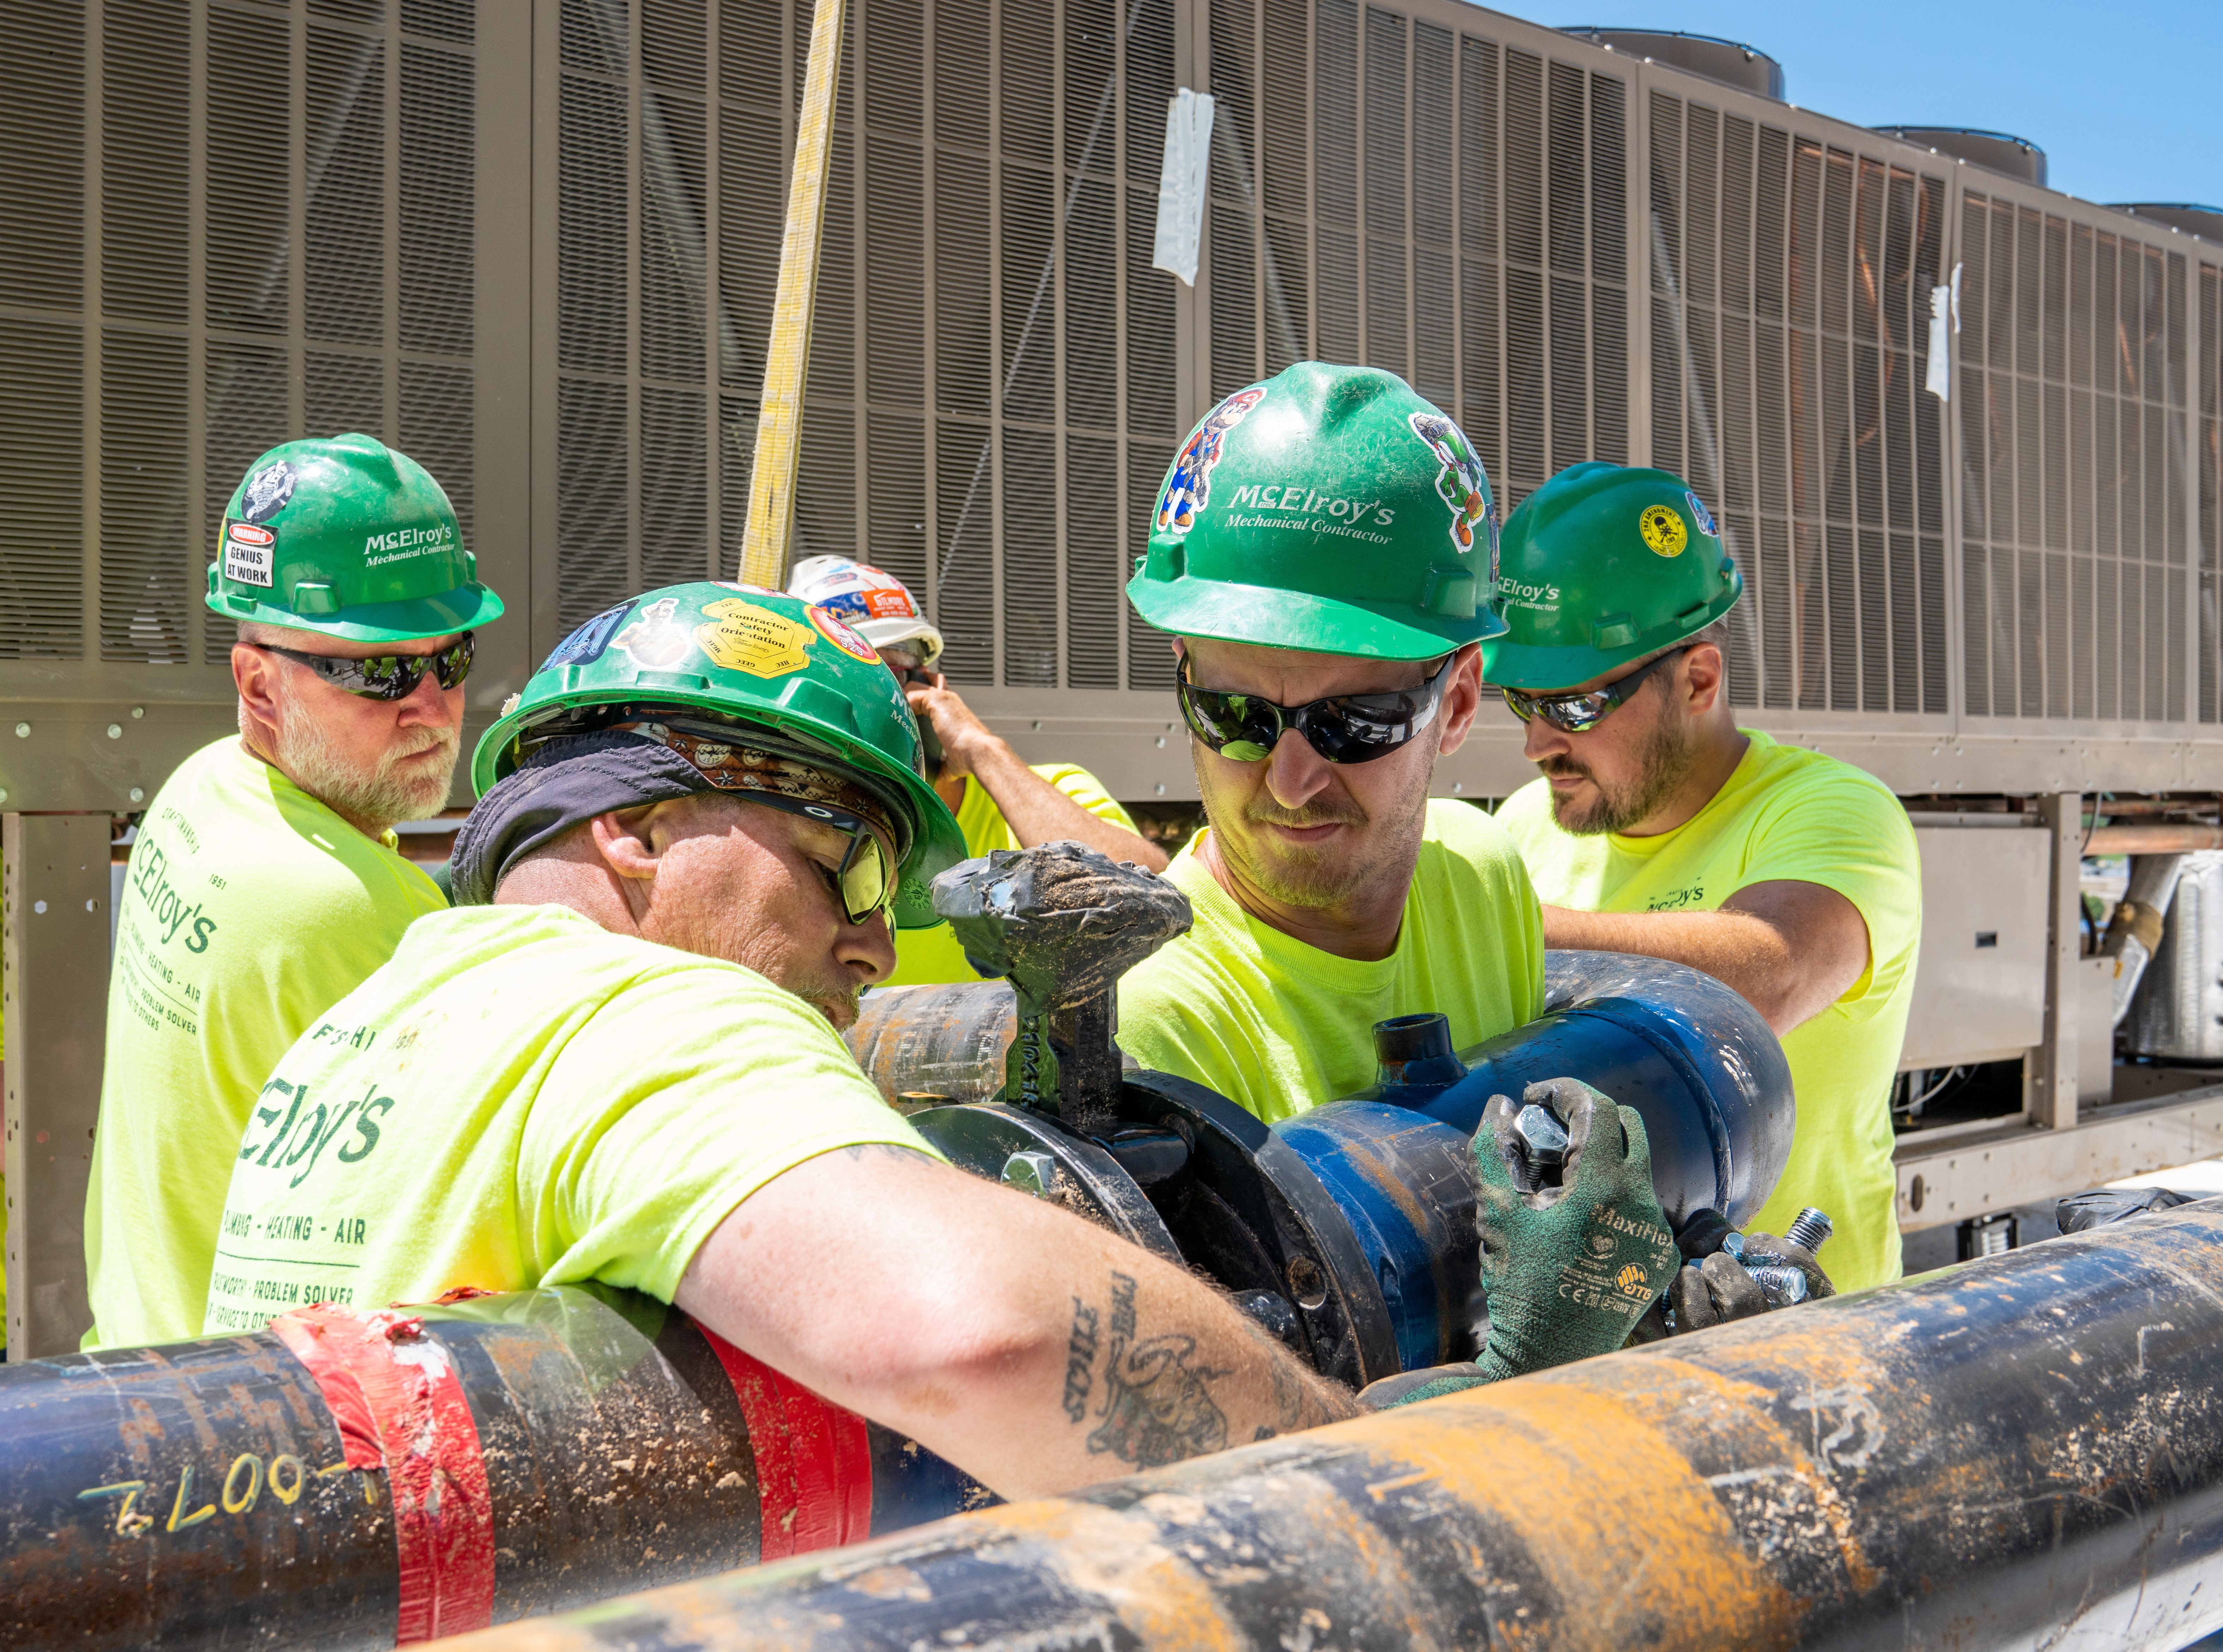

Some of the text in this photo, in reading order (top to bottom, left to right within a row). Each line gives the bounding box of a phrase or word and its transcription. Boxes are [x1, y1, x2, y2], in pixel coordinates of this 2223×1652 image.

[1227, 485, 1396, 525] McElroy's
[1645, 508, 1675, 520] AMENDMENT
[233, 527, 267, 543] WARNING
[364, 523, 452, 555] McElroy's
[1225, 514, 1393, 545] Mechanical Contractor
[231, 547, 263, 565] GENIUS
[366, 544, 455, 567] Mechanical Contractor
[228, 564, 268, 583] AT WORK
[1515, 598, 1559, 611] Contractor
[728, 613, 789, 631] Contractor
[739, 622, 773, 635] Safety
[706, 638, 722, 654] MGEC
[721, 627, 786, 649] Orientation
[753, 644, 770, 653] Energy
[839, 639, 863, 657] 929
[735, 659, 755, 668] GEEC
[777, 660, 790, 668] HEC
[162, 807, 199, 855] CRAFTSMANSHIP
[209, 873, 227, 890] 1951
[148, 950, 172, 984] HEATING
[185, 984, 201, 1004] AIR
[133, 997, 138, 1012] TO
[138, 1004, 159, 1031] OTHERS
[142, 987, 164, 1015] PROBLEM
[167, 1010, 197, 1036] SOLVER
[264, 1216, 312, 1241] HEATING
[334, 1219, 366, 1245] AIR
[253, 1280, 299, 1304] PROBLEM
[304, 1285, 353, 1306] SOLVER
[241, 1310, 249, 1329] TO
